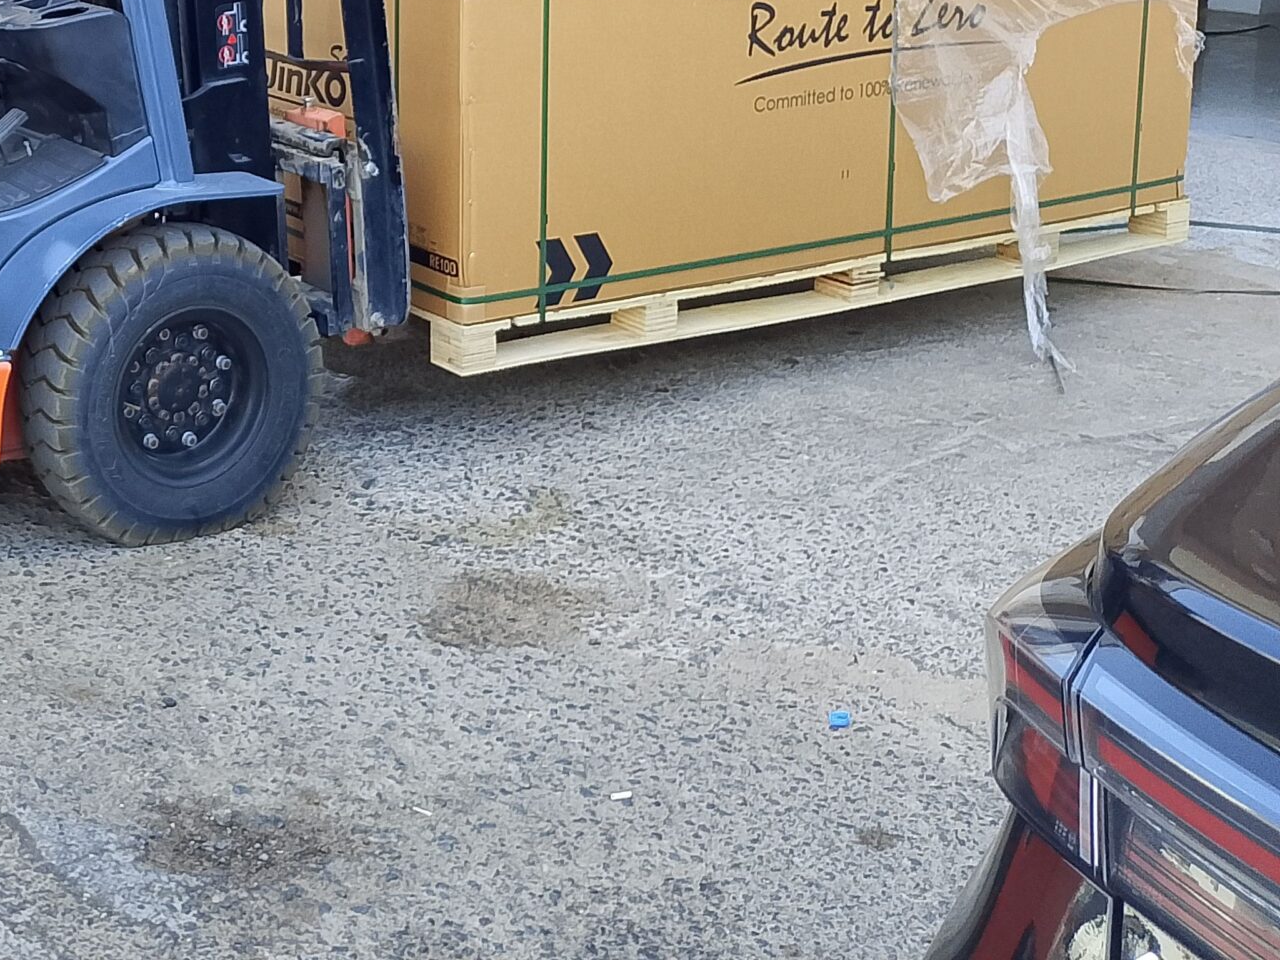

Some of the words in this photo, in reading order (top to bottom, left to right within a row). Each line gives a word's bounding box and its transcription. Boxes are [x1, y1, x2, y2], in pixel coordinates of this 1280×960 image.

[748, 1, 850, 58] Route
[753, 82, 836, 113] Committed
[839, 84, 854, 102] to
[429, 254, 458, 276] RE100
